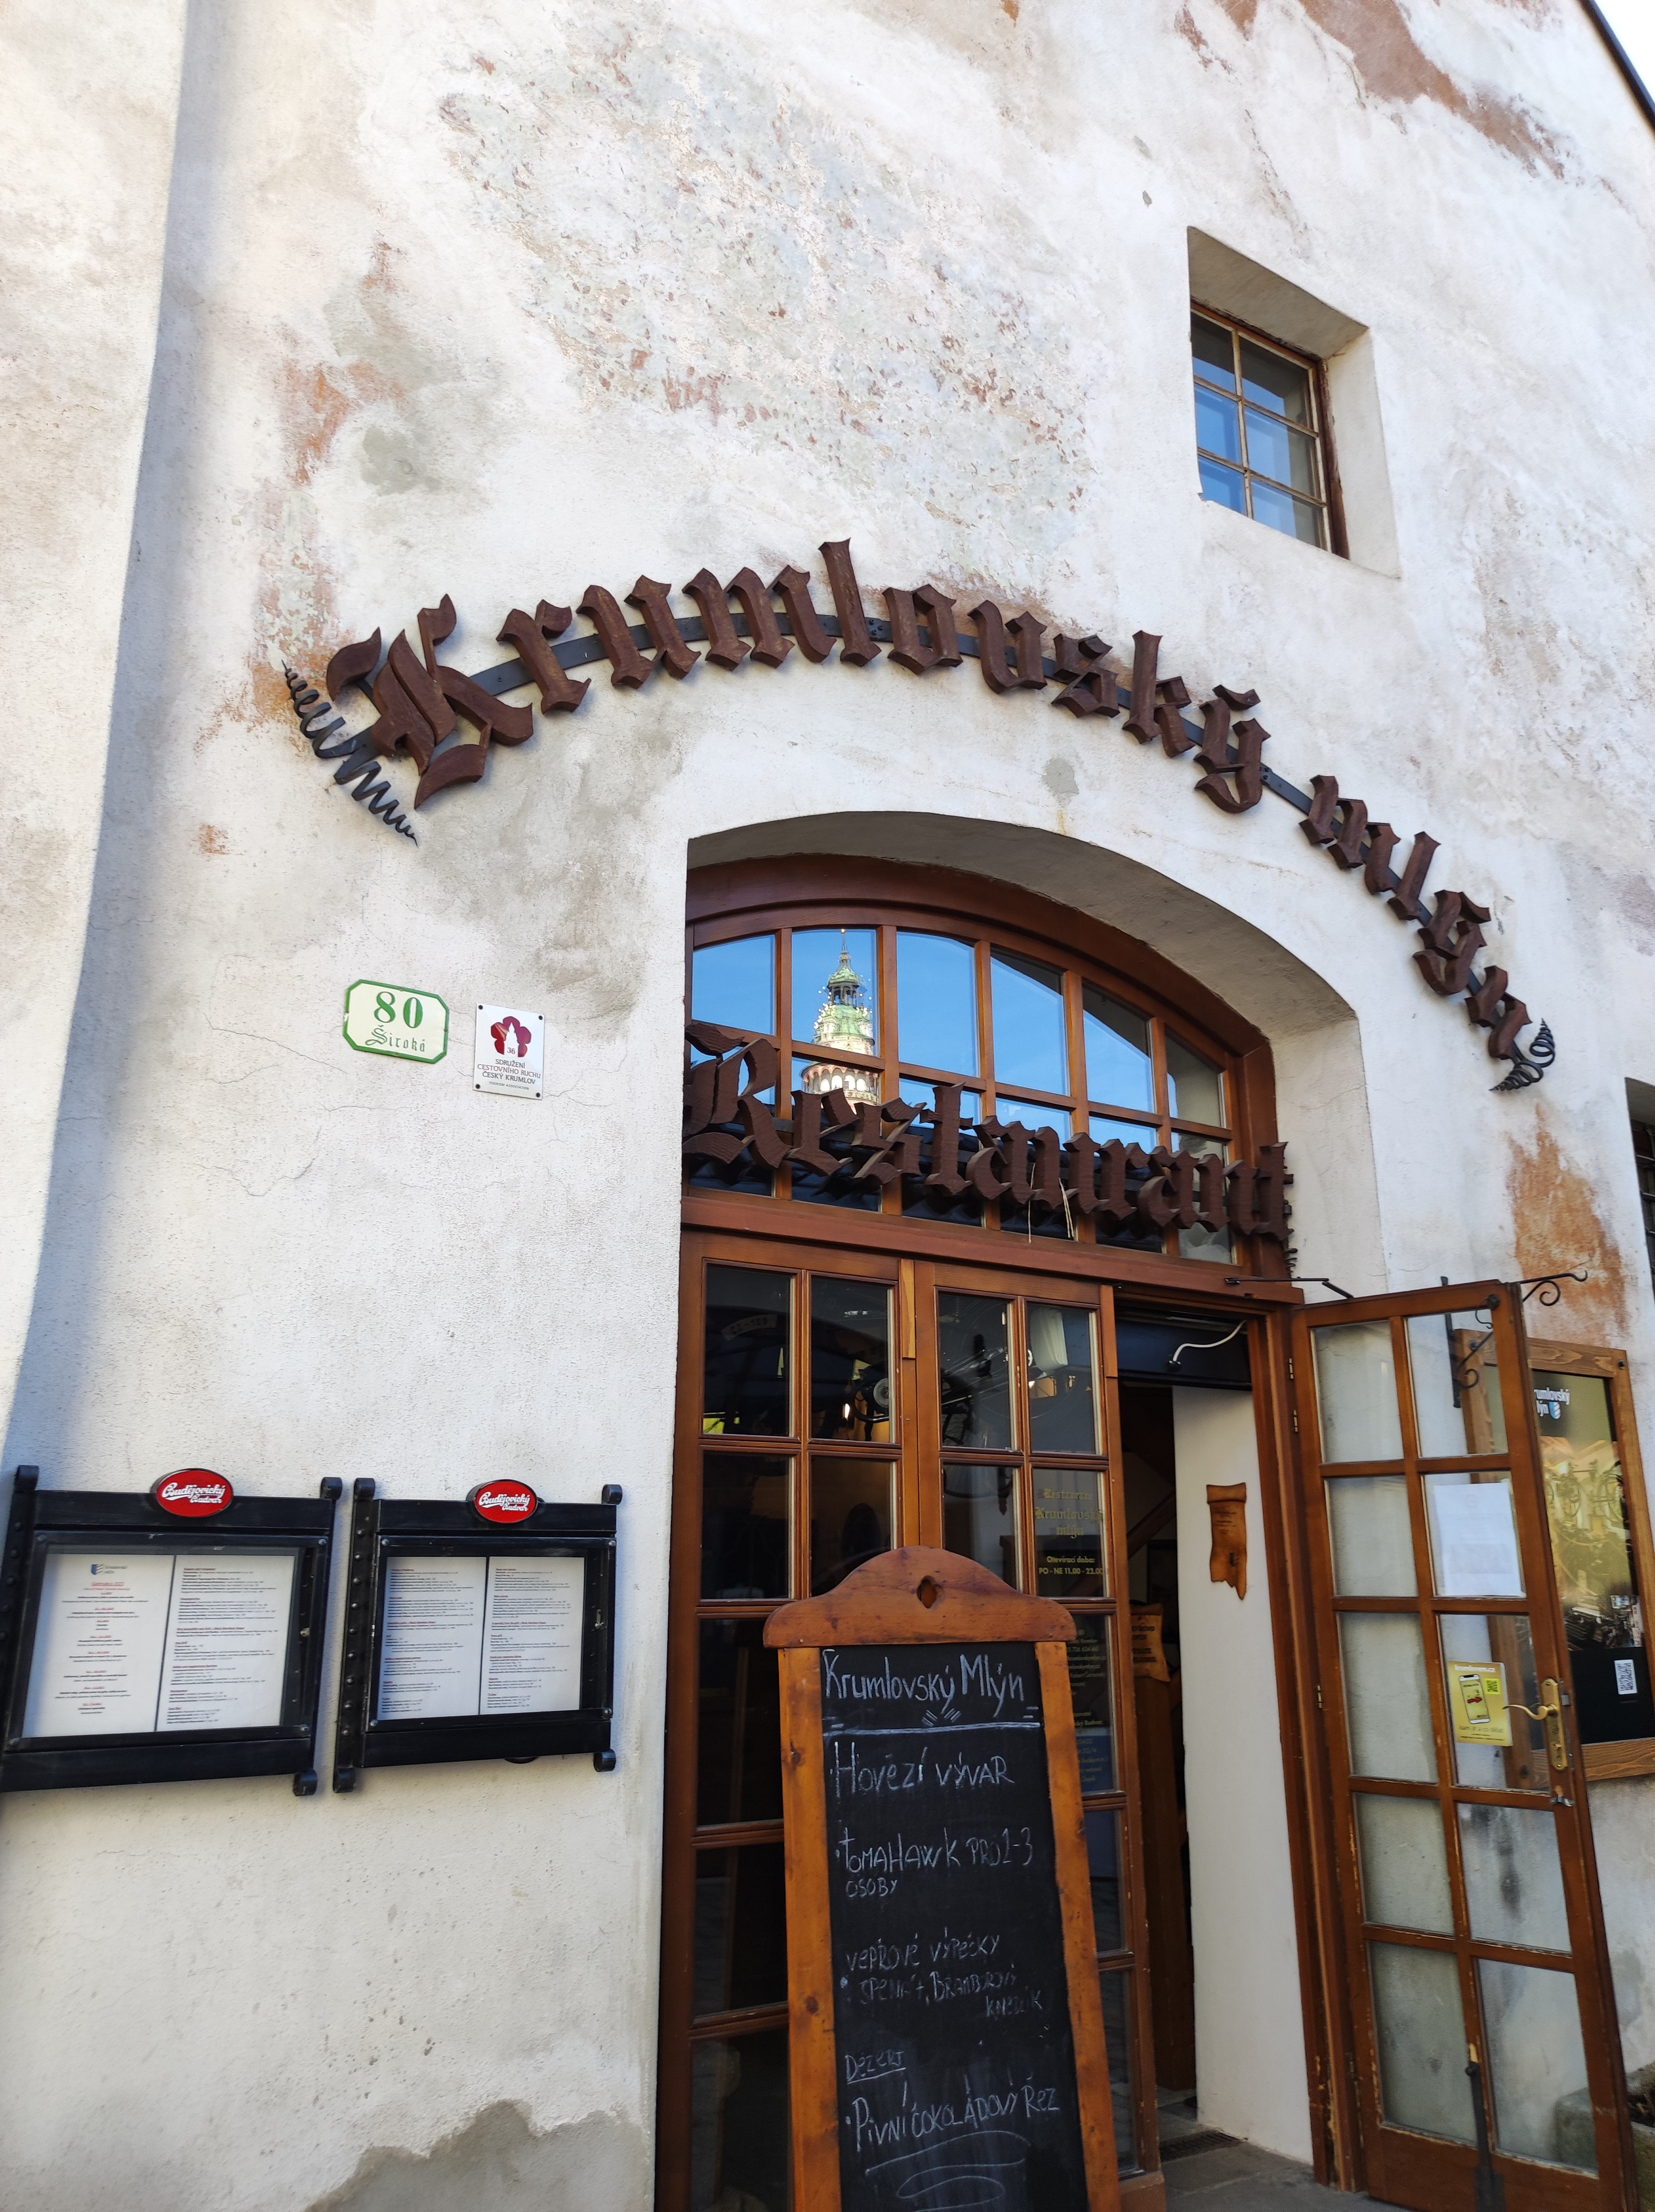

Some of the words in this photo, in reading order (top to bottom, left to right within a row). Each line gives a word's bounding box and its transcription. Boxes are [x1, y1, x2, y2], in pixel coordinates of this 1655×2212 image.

[374, 991, 423, 1029] 80
[365, 1025, 426, 1053] Široká
[477, 1064, 519, 1075] CESTOVNÍHO
[521, 1070, 541, 1079] RUCHU
[495, 1058, 525, 1069] SDRUŽENÍ
[482, 1071, 504, 1080] ČESKÝ
[505, 1074, 536, 1085] KRUMLOV
[822, 1649, 955, 1715] Krumlovský
[960, 1653, 1025, 1717] Mlýn
